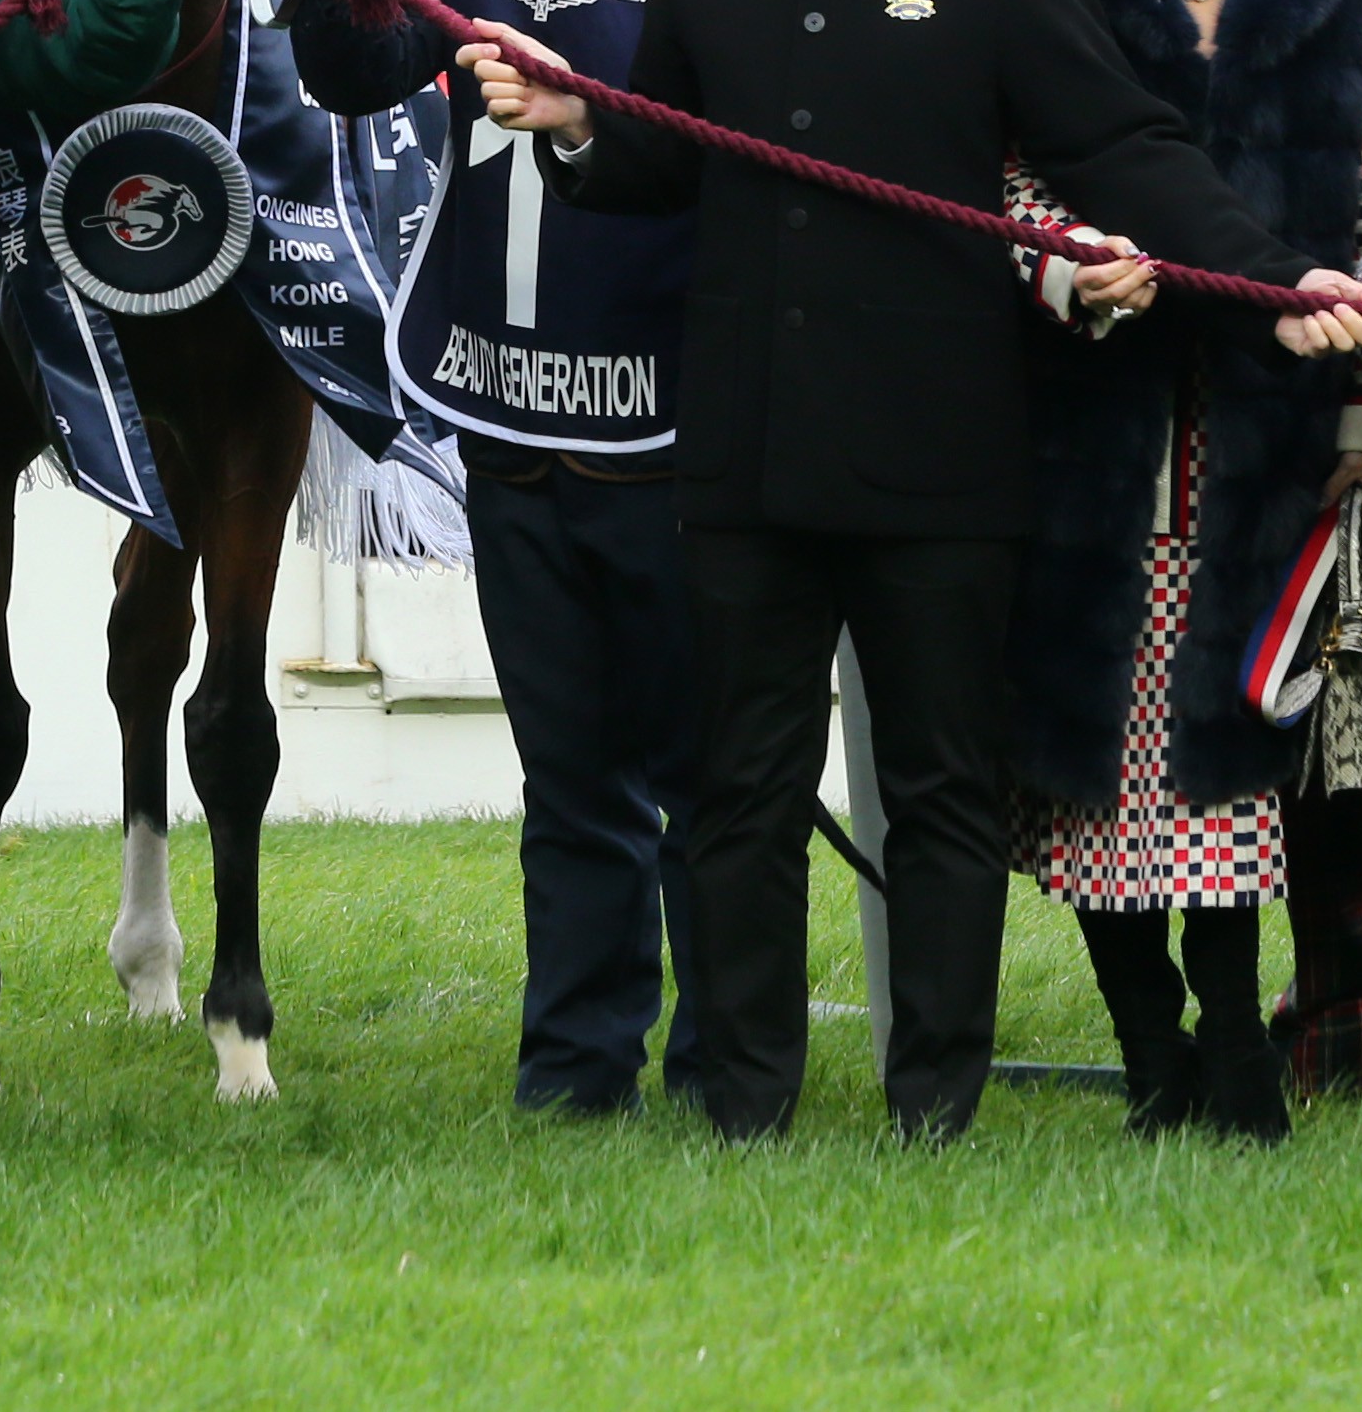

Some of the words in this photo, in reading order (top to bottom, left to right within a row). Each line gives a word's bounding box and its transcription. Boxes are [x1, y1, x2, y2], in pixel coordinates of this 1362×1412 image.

[254, 195, 339, 229] ONGINES
[469, 114, 544, 329] 1
[268, 239, 335, 263] HONG
[270, 282, 349, 306] KONG
[279, 326, 345, 348] MILE
[433, 324, 499, 399] BEAUTY
[499, 344, 656, 417] GENERATION
